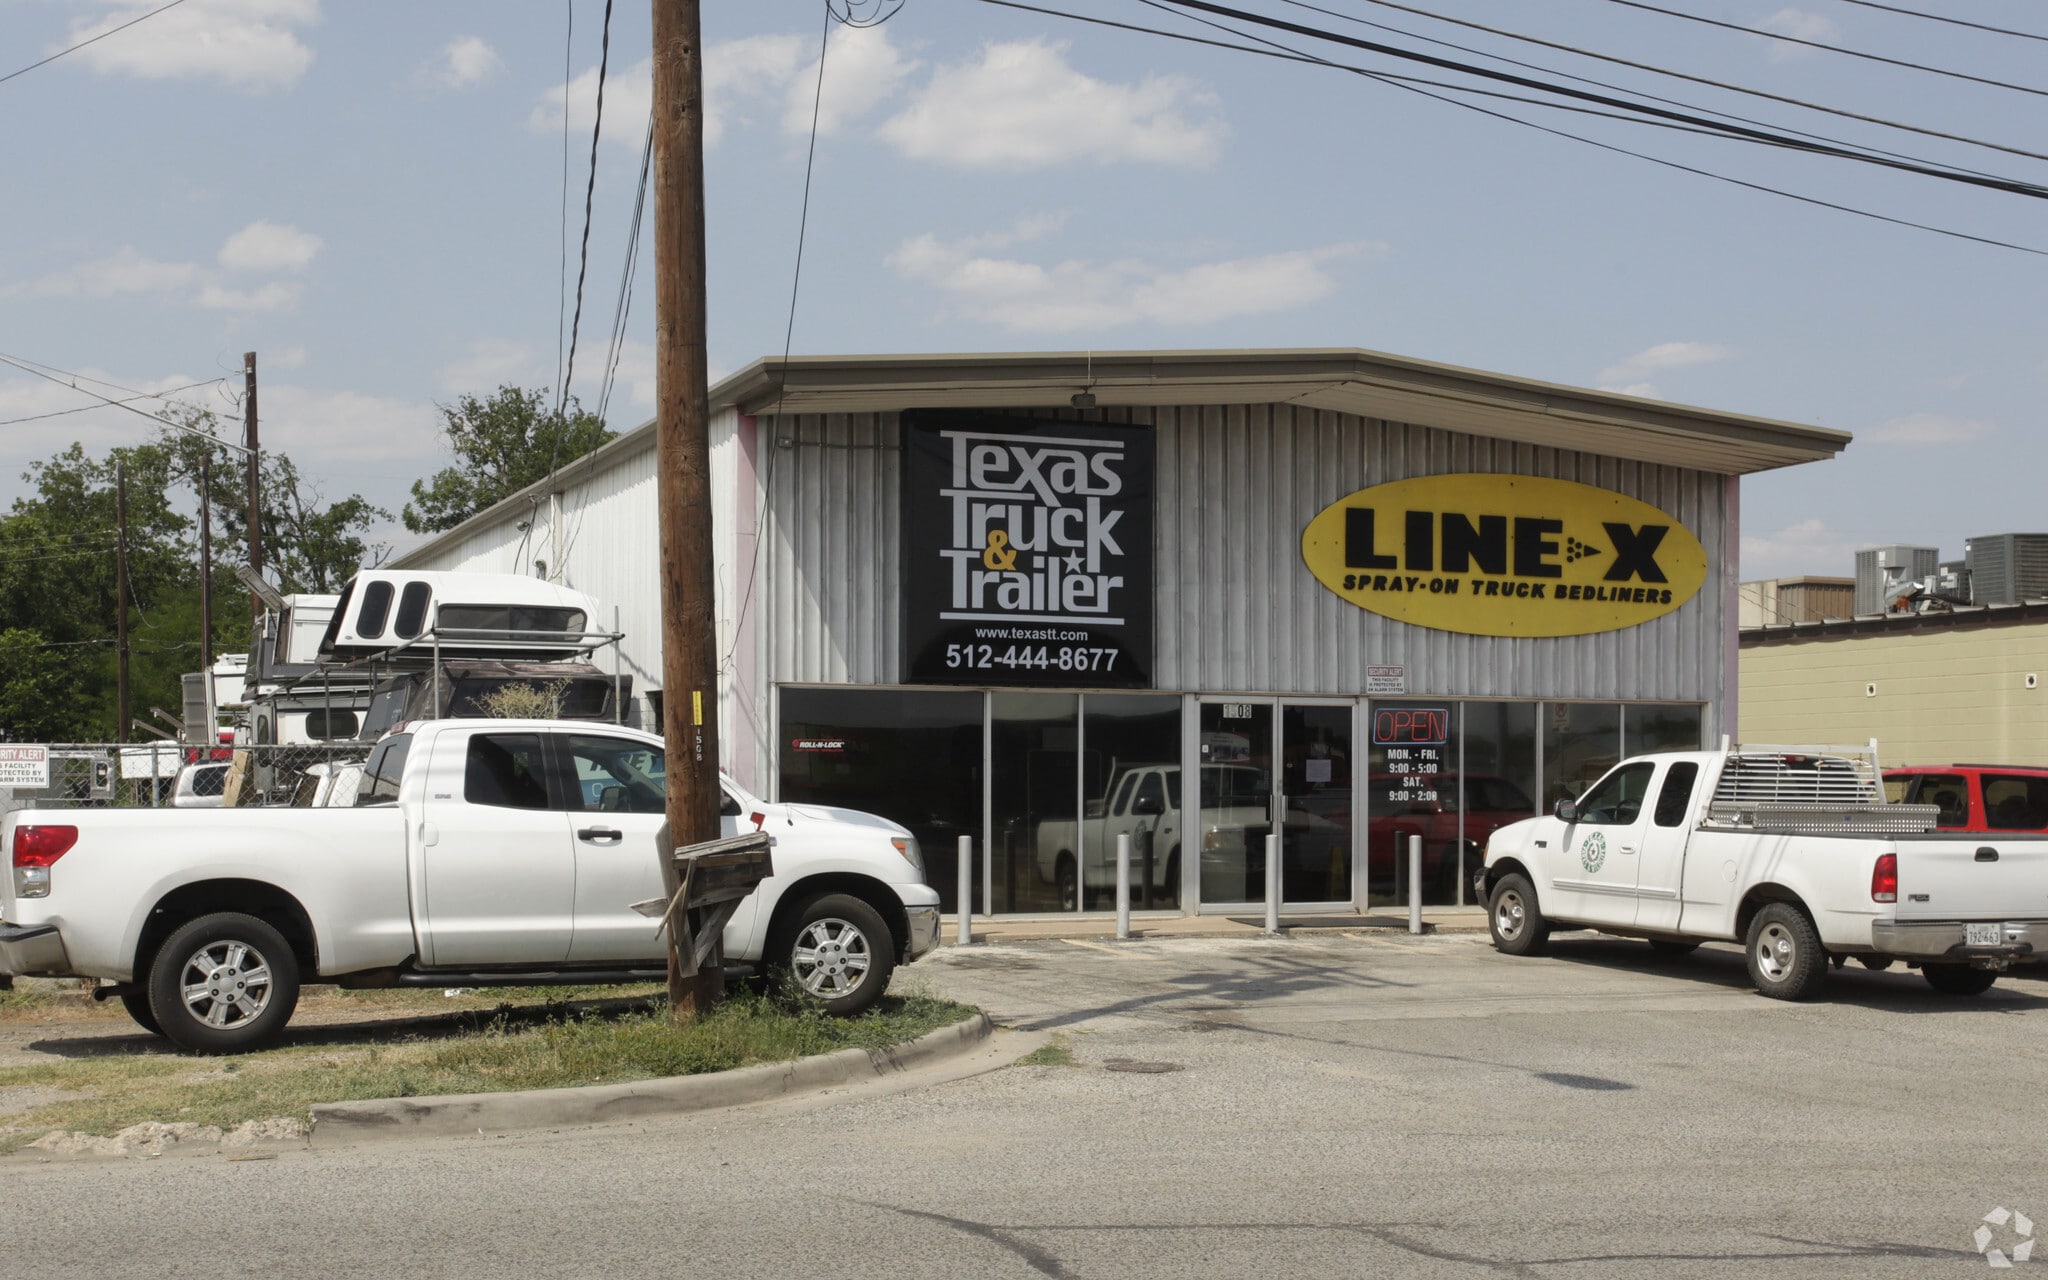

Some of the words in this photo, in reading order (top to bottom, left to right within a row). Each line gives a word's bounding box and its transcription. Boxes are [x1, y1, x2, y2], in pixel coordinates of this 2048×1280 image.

[940, 430, 1125, 507] Texas
[940, 489, 1125, 573] Truck
[983, 529, 1017, 571] &
[940, 550, 1124, 612] Trailer
[1343, 574, 1459, 595] SPRAY-ON
[1471, 579, 1546, 599] TRUCK
[1554, 584, 1673, 605] BEDLINERS
[975, 628, 1089, 642] www.texastt.com
[946, 644, 1119, 671] 512-444-8677
[1377, 711, 1445, 742] OPEN
[19, 750, 43, 760] ALERT
[1387, 749, 1412, 760] MON.
[1421, 749, 1439, 760] FRI.
[1389, 763, 1409, 774] 9:00
[1418, 763, 1438, 774] 5:00
[1402, 776, 1424, 788] SAT.
[1389, 790, 1409, 801] 9:00
